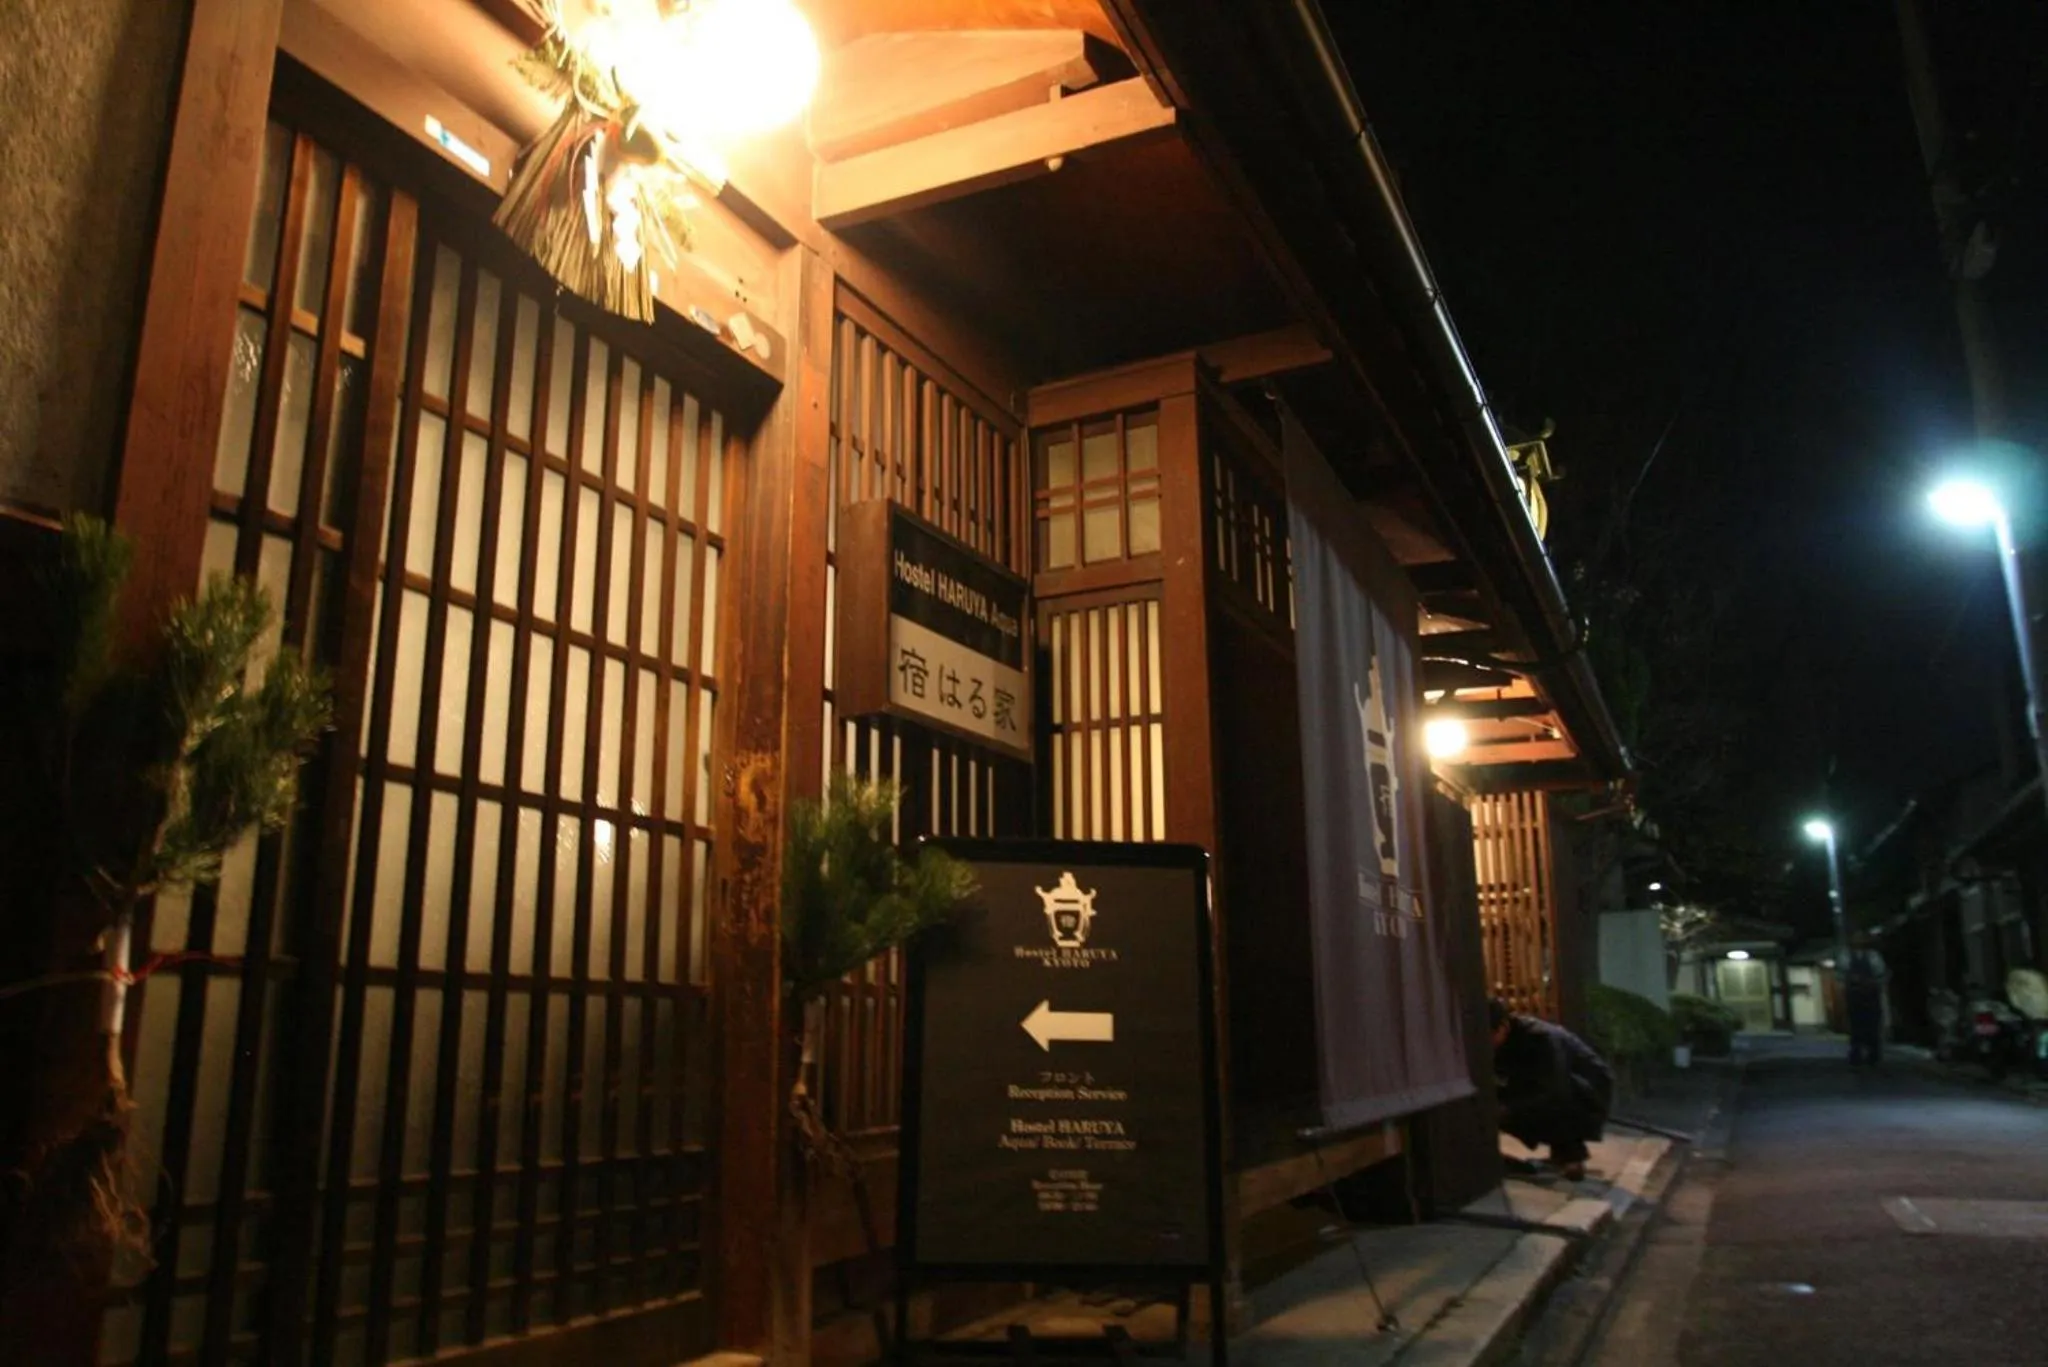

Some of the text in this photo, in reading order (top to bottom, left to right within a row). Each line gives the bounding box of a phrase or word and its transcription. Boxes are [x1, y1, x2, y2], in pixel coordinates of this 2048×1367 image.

[894, 550, 934, 595] Hostel
[938, 572, 988, 624] HARUYA
[898, 648, 1017, 732] 宿はる家
